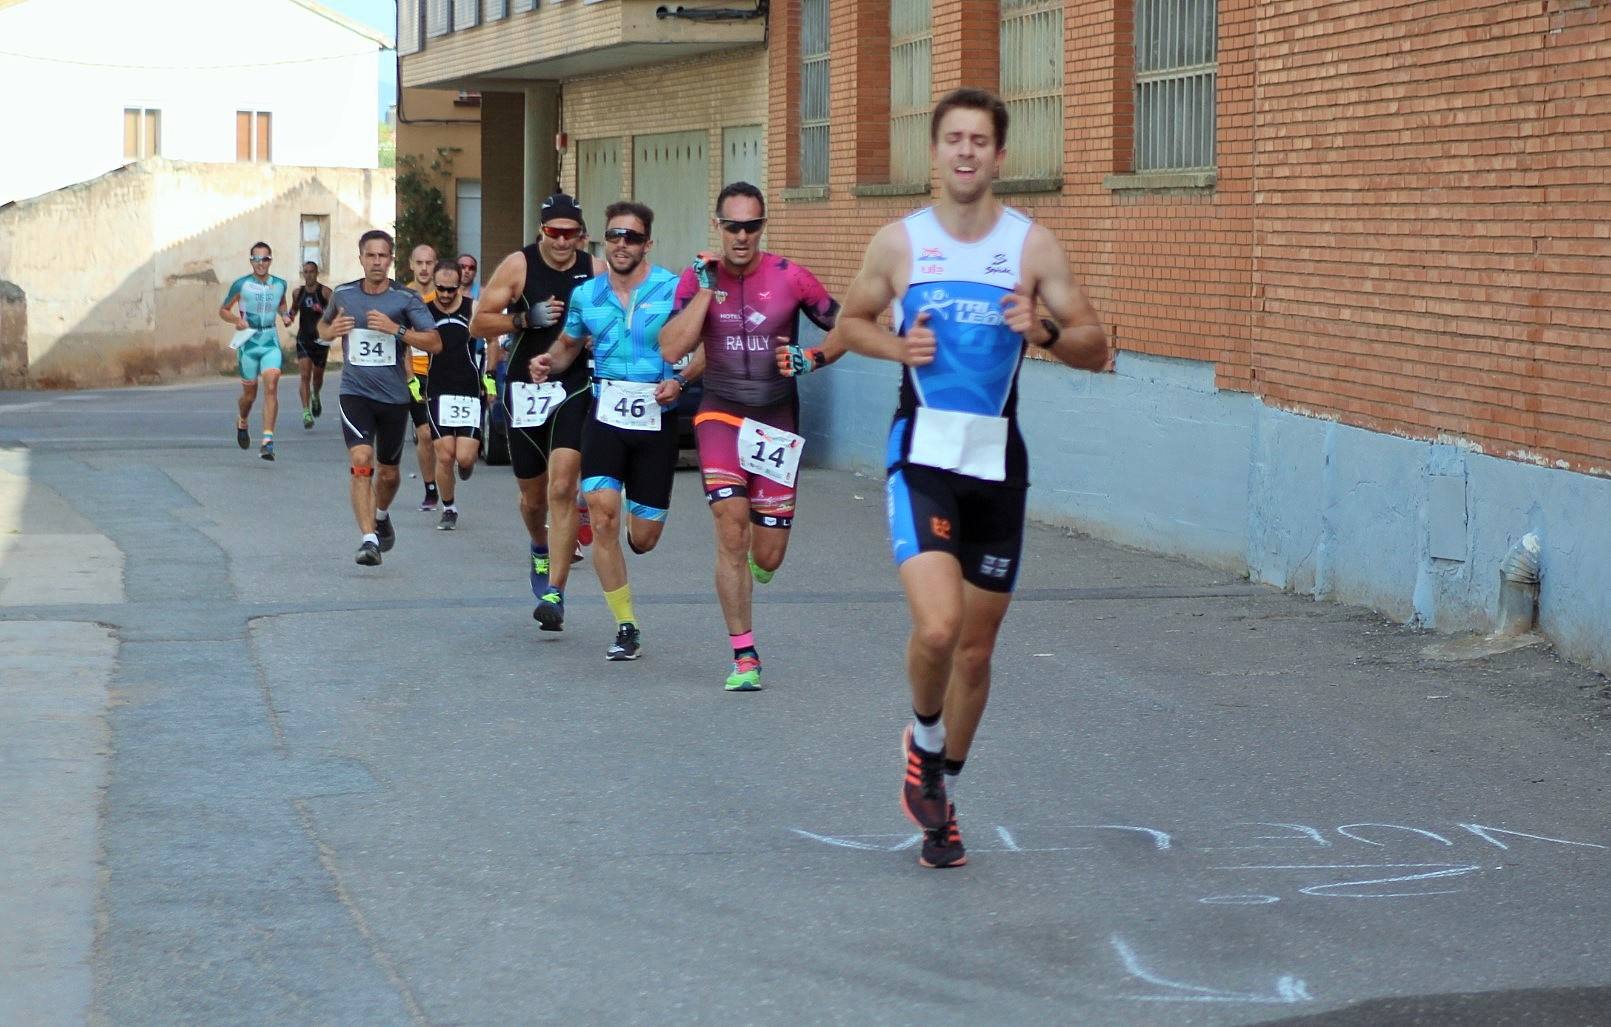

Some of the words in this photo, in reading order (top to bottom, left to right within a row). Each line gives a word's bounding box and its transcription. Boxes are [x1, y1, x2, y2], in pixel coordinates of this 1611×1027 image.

[359, 341, 384, 357] 34
[450, 405, 471, 419] 35
[526, 396, 551, 416] 27
[614, 397, 646, 418] 46
[751, 441, 785, 469] 14
